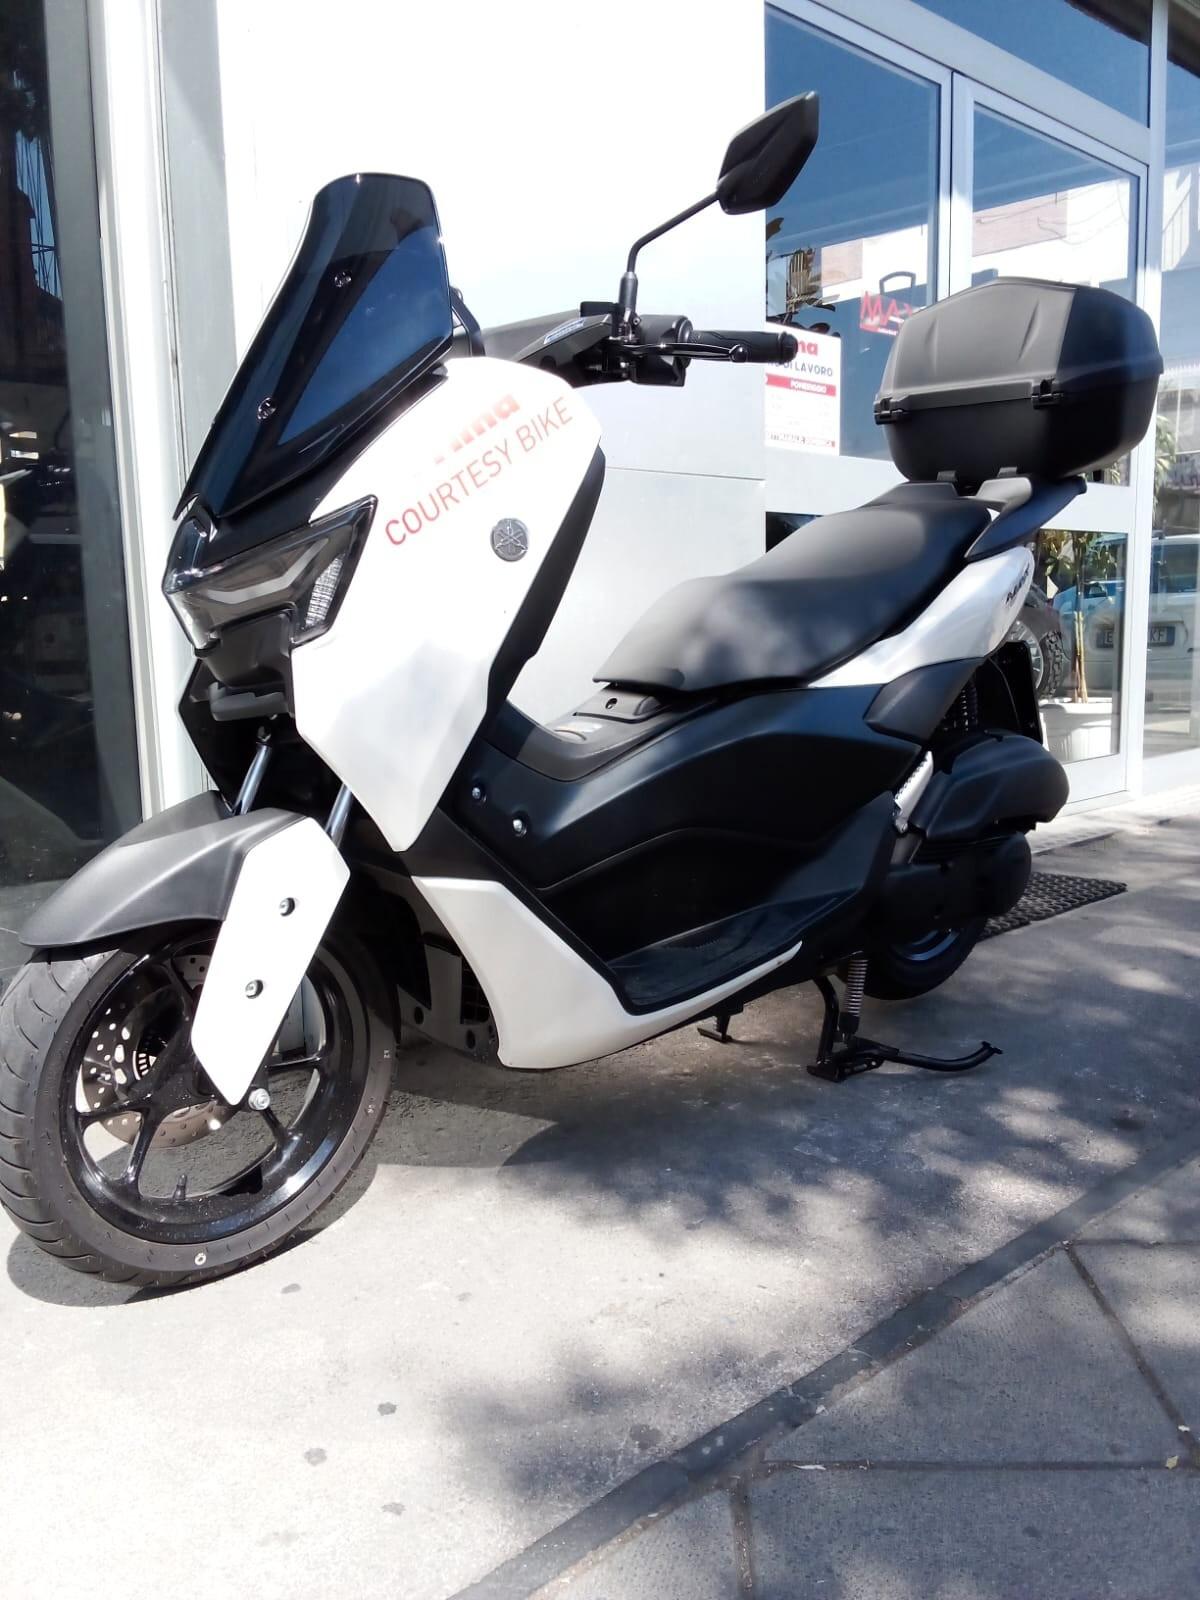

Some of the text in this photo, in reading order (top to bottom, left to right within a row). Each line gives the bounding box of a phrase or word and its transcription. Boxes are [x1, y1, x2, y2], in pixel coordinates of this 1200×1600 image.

[794, 360, 833, 377] LAVORO
[385, 438, 513, 546] COURTESY
[515, 396, 573, 453] BIKE
